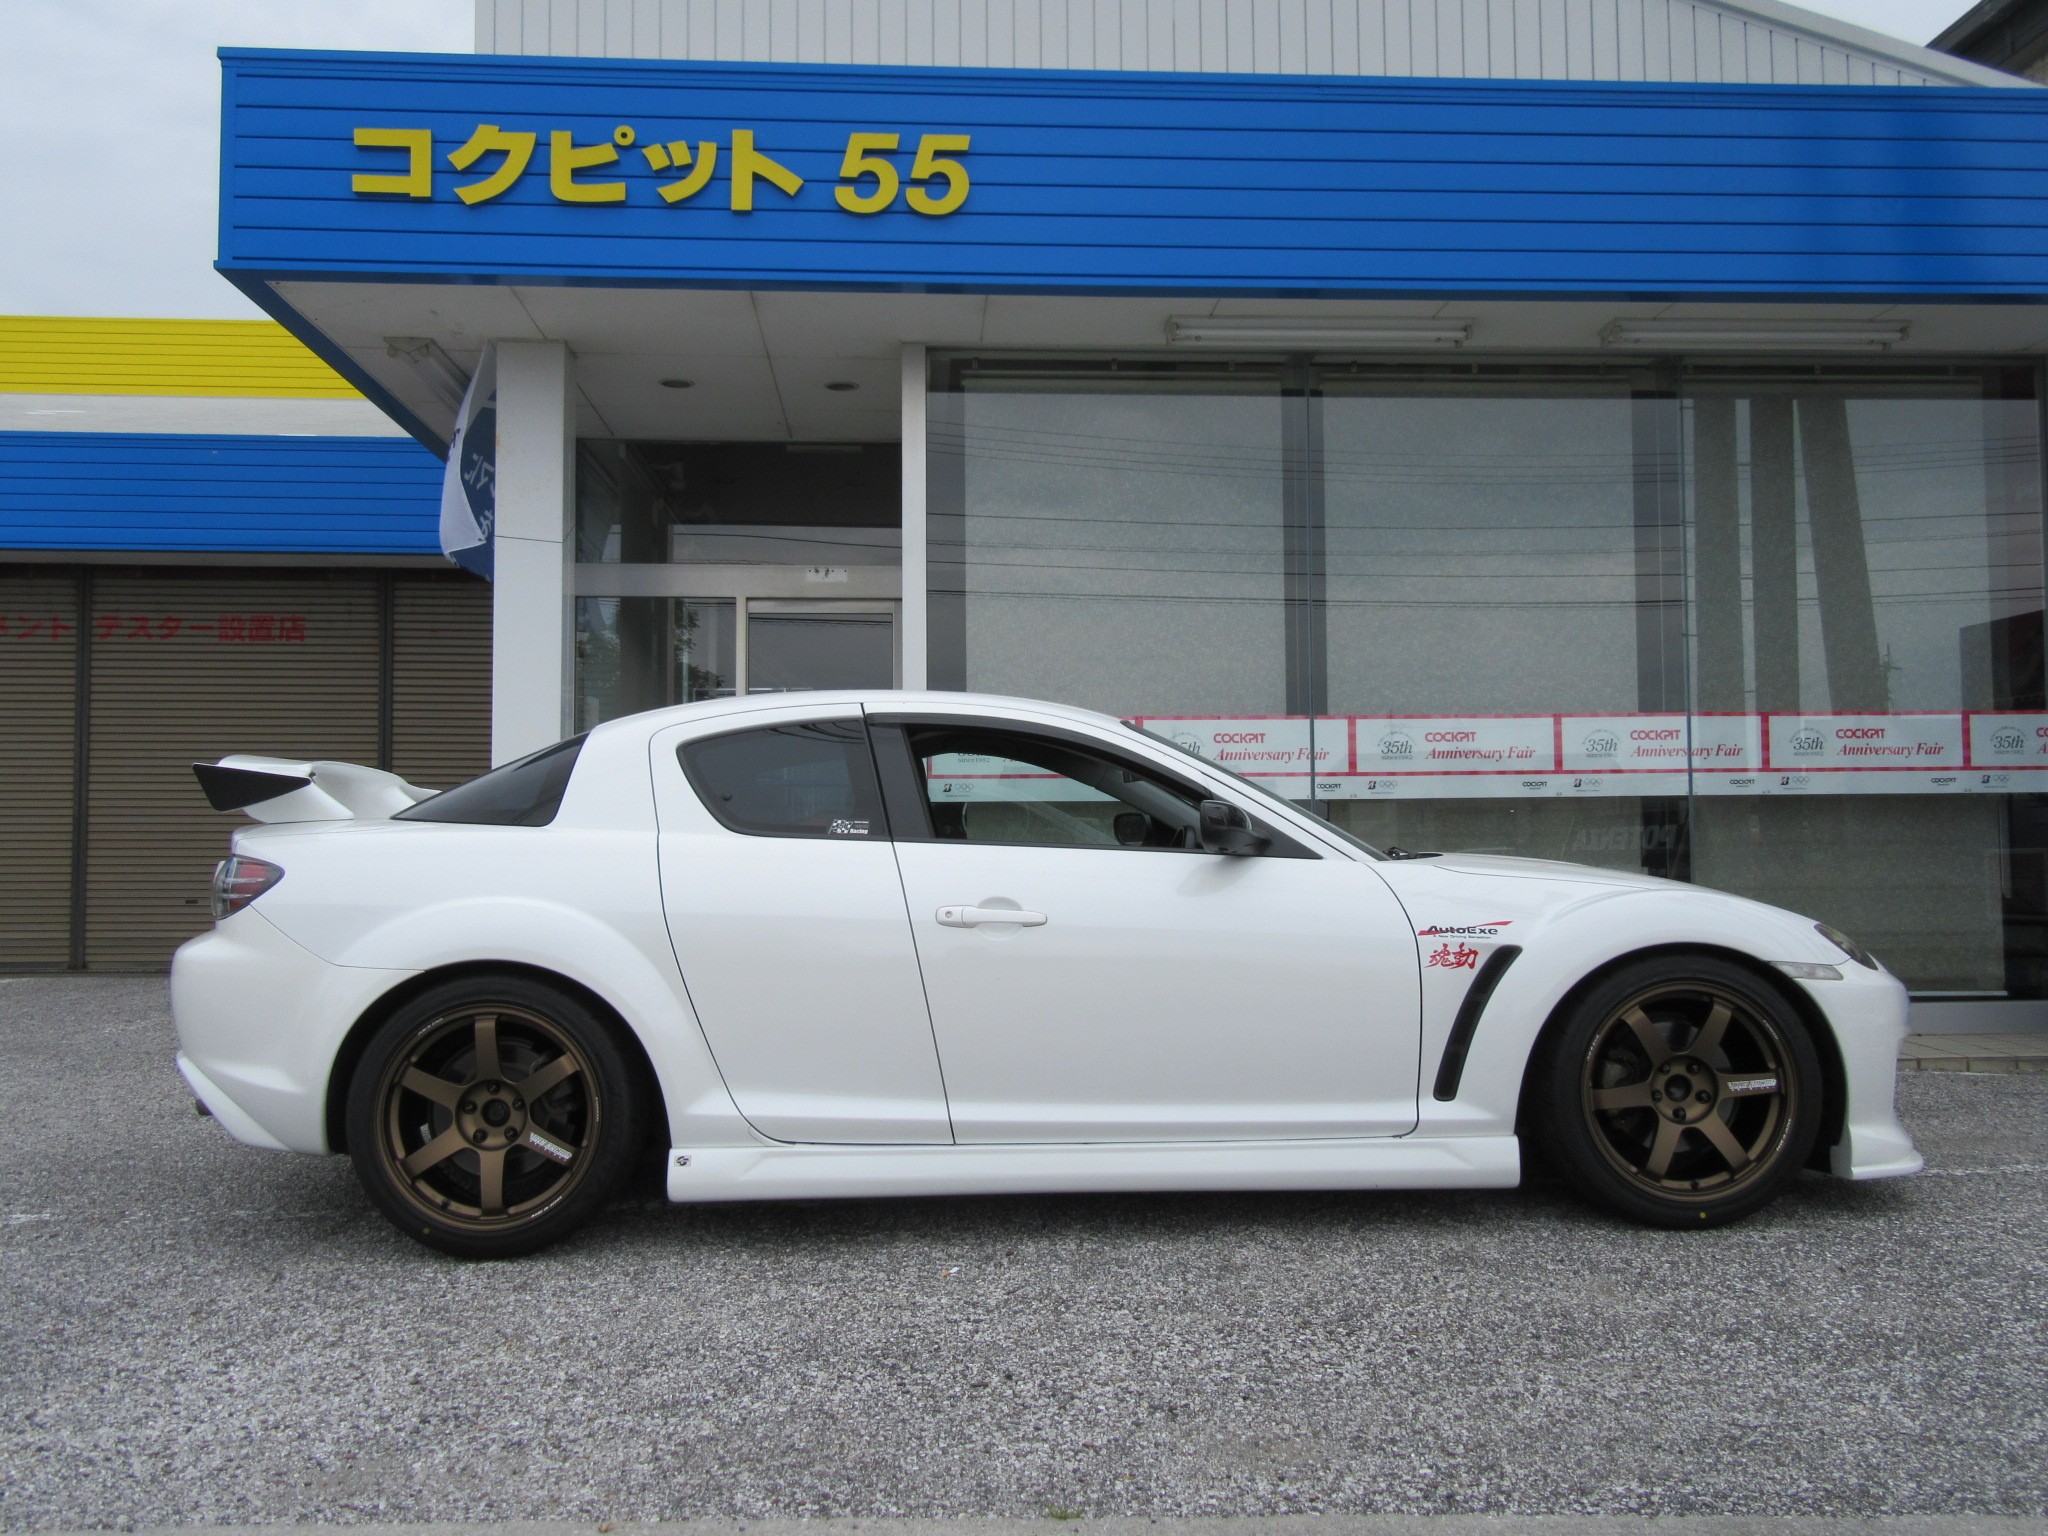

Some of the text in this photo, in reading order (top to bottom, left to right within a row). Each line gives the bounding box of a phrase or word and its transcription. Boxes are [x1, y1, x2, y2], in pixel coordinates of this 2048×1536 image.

[352, 124, 971, 215] コクピット 55
[1213, 733, 1266, 744] COCKPIT
[1425, 732, 1476, 742] COCKPIT
[1630, 730, 1681, 740] COCKPIT
[1836, 729, 1886, 739] COCKPIT
[1381, 740, 1413, 754] 35th
[1586, 739, 1617, 752] 35th
[1793, 737, 1823, 750] 35th
[1994, 735, 2024, 748] 35th
[1213, 748, 1294, 763] Anniversary
[1425, 746, 1535, 762] Anniversary Fair
[1716, 744, 1743, 757] Fair
[1836, 742, 1944, 758] Anniversary Fair
[1426, 926, 1498, 935] AutoExe
